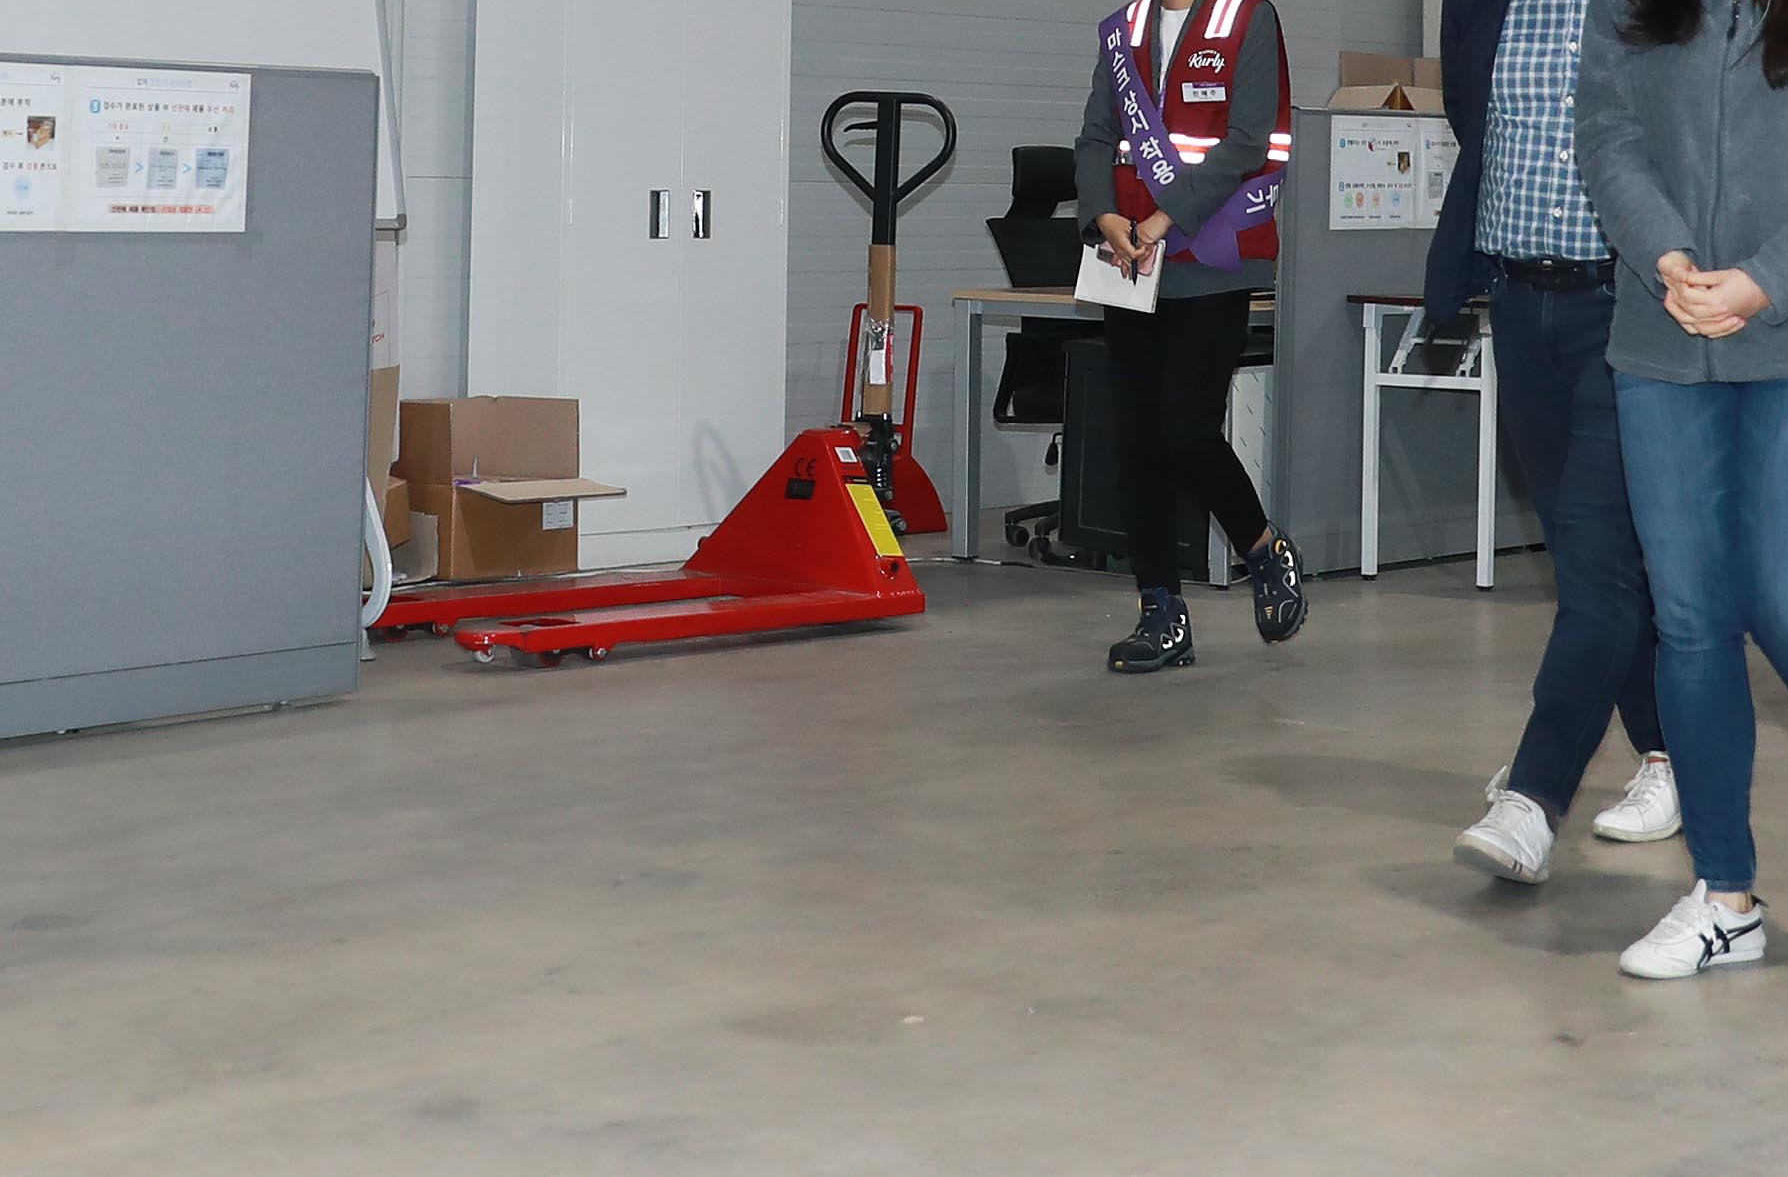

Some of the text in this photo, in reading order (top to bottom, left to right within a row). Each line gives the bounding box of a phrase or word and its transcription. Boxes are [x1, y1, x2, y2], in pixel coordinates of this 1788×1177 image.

[1107, 28, 1175, 185] 마스크 상시 착용
[1187, 52, 1226, 74] Kurly
